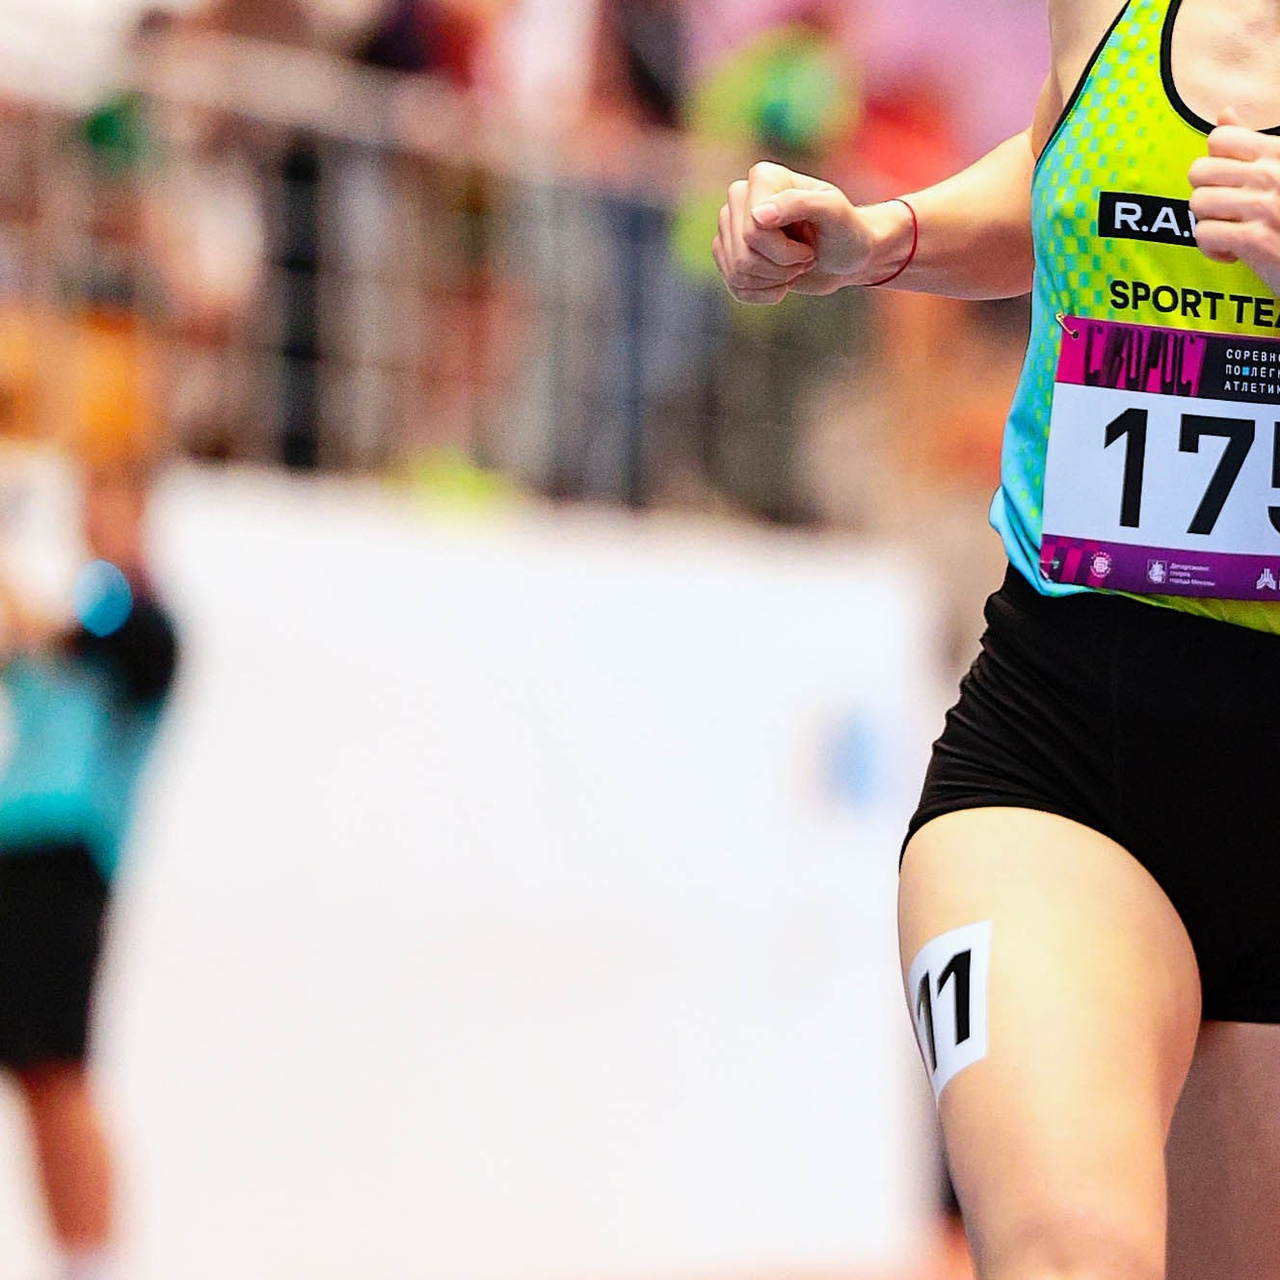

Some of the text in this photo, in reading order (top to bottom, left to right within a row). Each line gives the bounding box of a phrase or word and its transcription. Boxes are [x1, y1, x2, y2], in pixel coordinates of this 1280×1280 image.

[1110, 280, 1224, 320] SPORT
[1225, 364, 1241, 376] ПО
[917, 948, 972, 1073] 11
